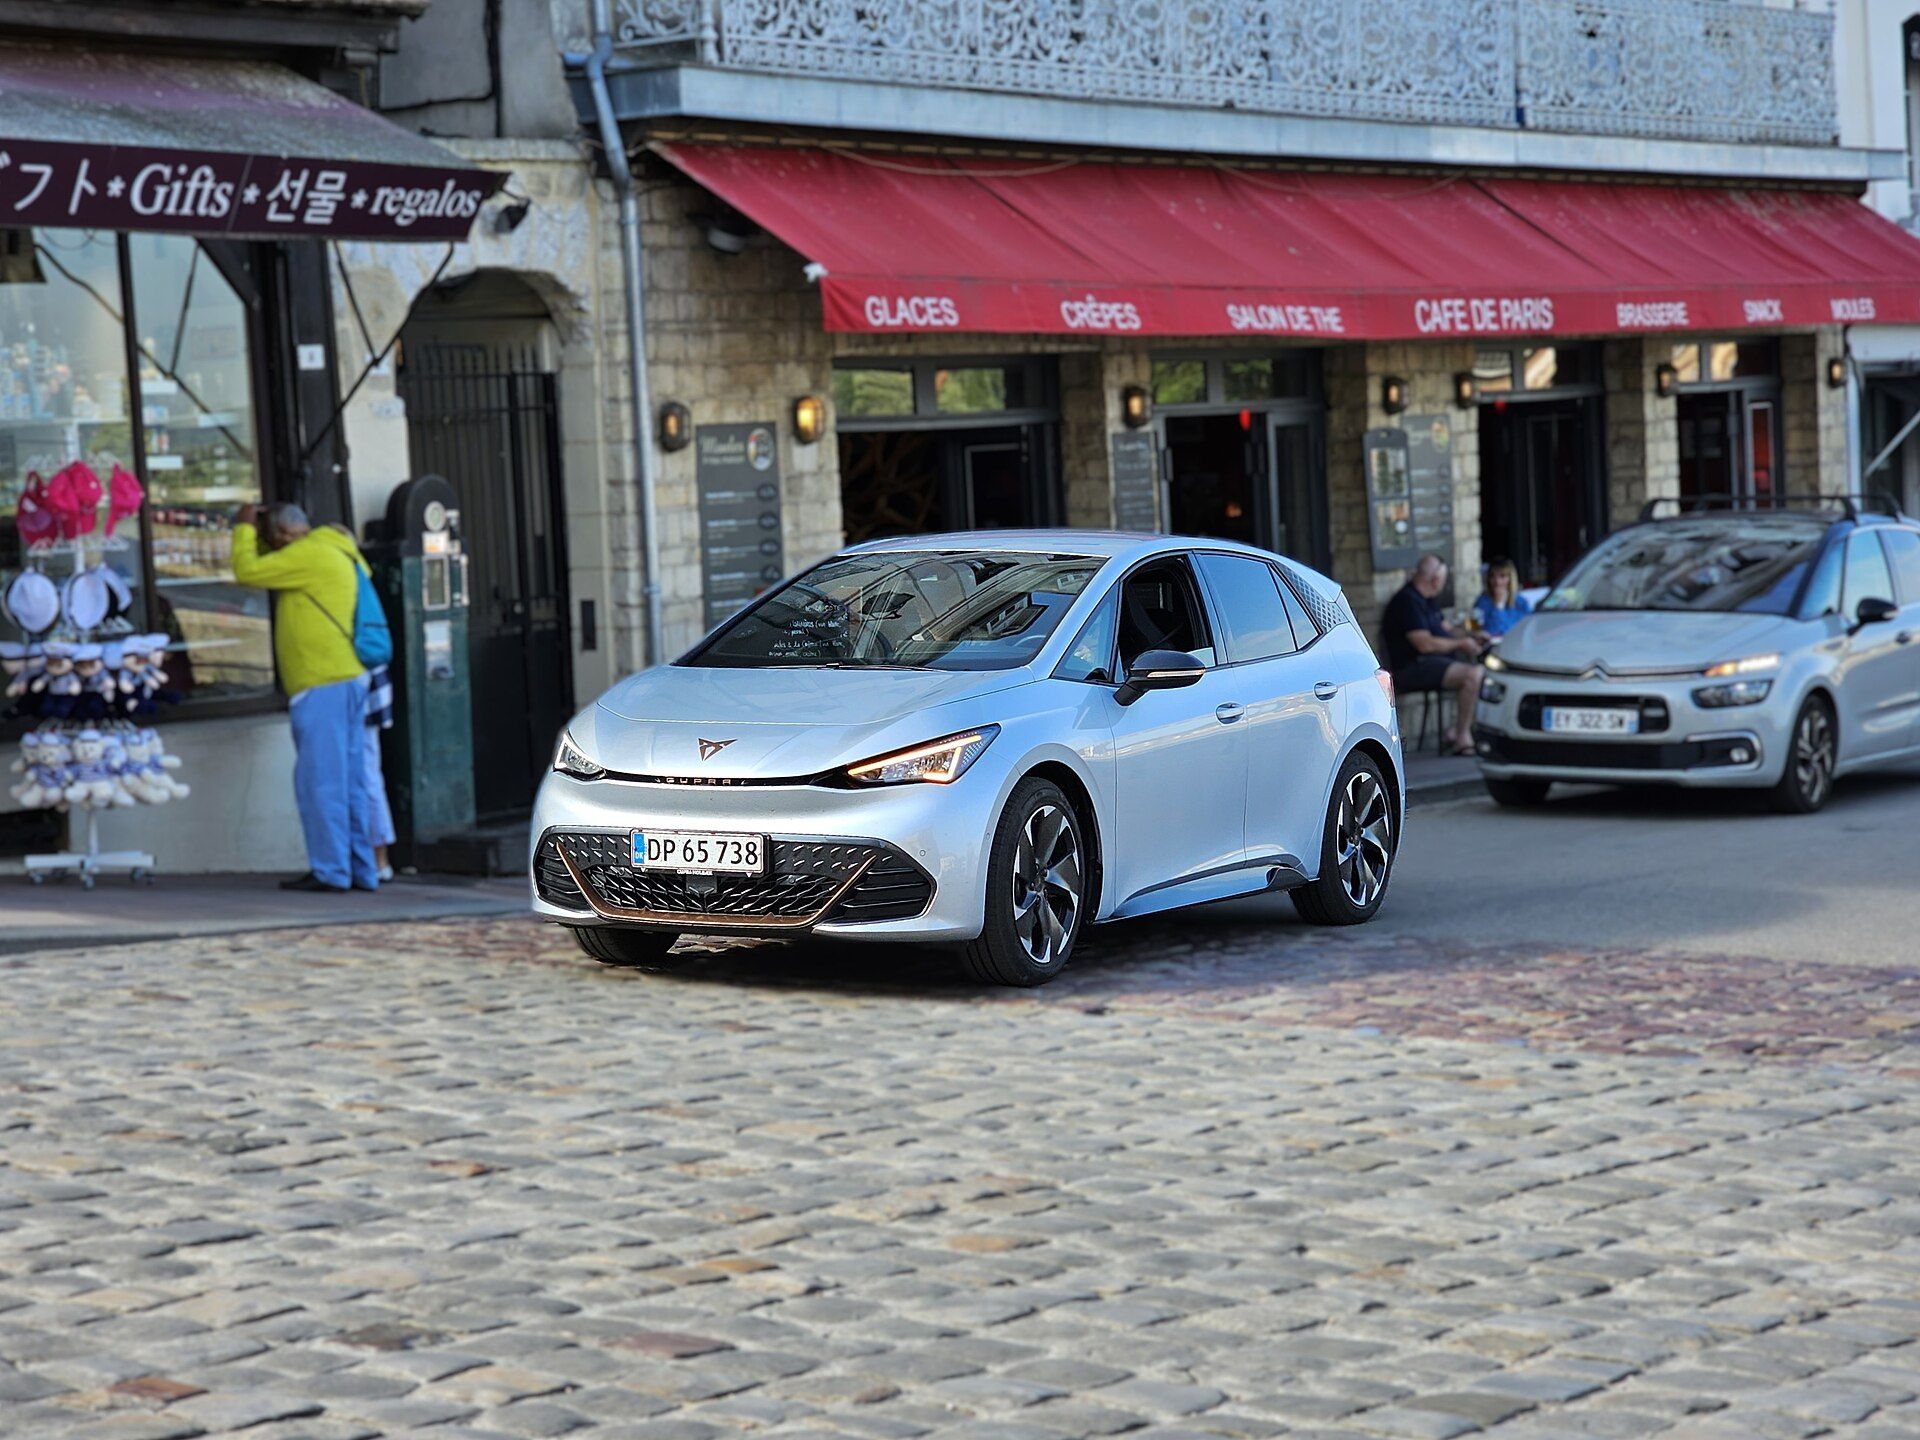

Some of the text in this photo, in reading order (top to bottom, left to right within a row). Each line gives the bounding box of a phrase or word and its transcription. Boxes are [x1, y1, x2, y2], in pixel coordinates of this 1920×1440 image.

[0, 151, 97, 216] フト
[130, 162, 235, 218] Gifts
[266, 168, 348, 225] 선물
[369, 178, 483, 226] regalos
[864, 294, 959, 327] GLACES
[1060, 294, 1142, 330] CRÊPES
[1226, 303, 1346, 333] SALON DE THE
[1414, 297, 1555, 333] CAFE DE PARIS
[1615, 301, 1690, 328] BRASSERIE
[1743, 299, 1784, 323] SNACK
[1829, 297, 1876, 321] MOULES
[647, 838, 758, 865] DP 65 738
